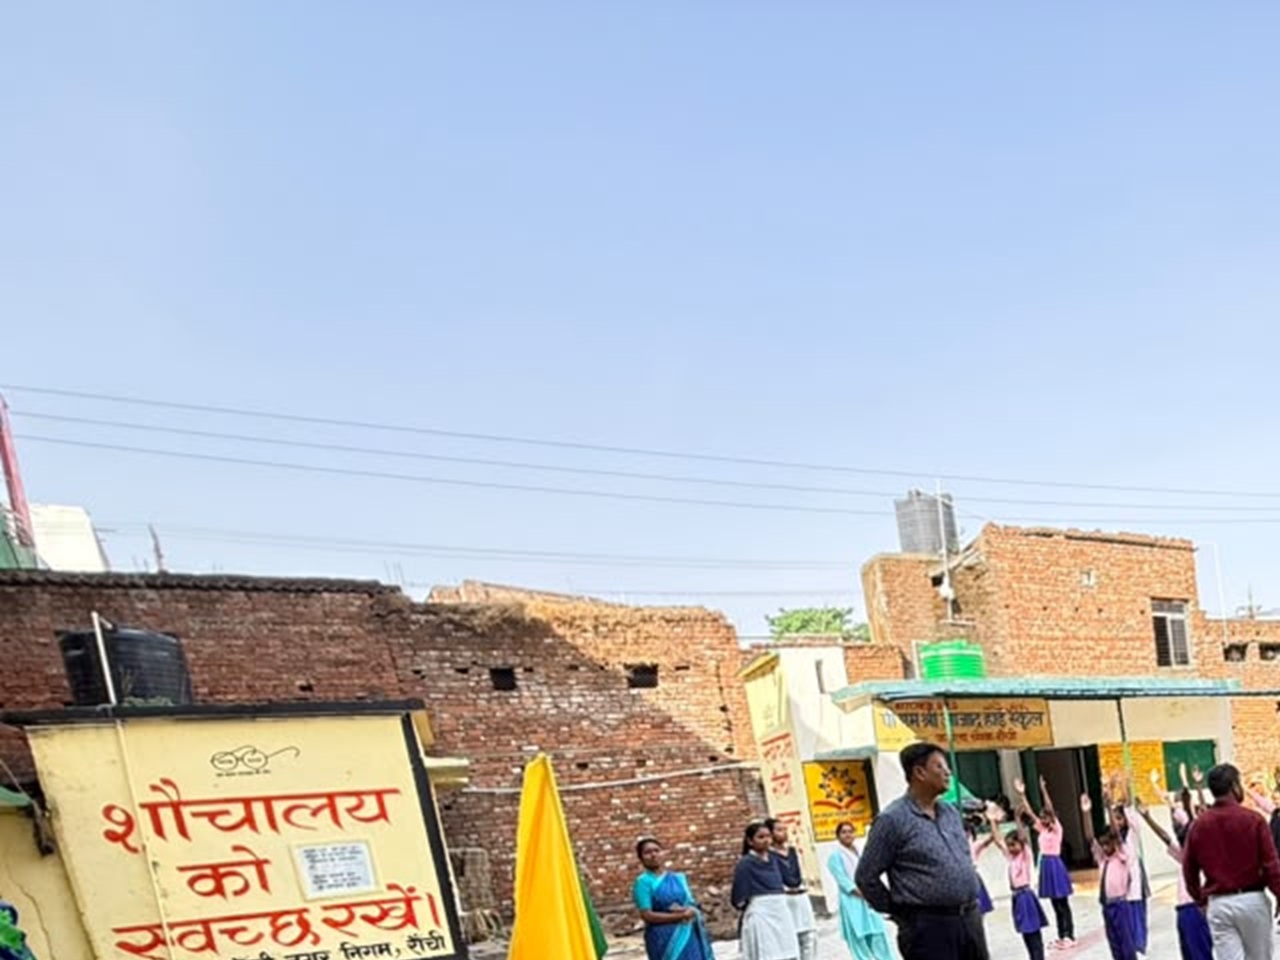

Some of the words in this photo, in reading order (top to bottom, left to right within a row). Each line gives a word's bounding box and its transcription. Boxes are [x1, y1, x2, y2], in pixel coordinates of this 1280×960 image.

[101, 778, 402, 854] शौचालय
[176, 845, 271, 900] को
[112, 907, 321, 960] स्वच्छ
